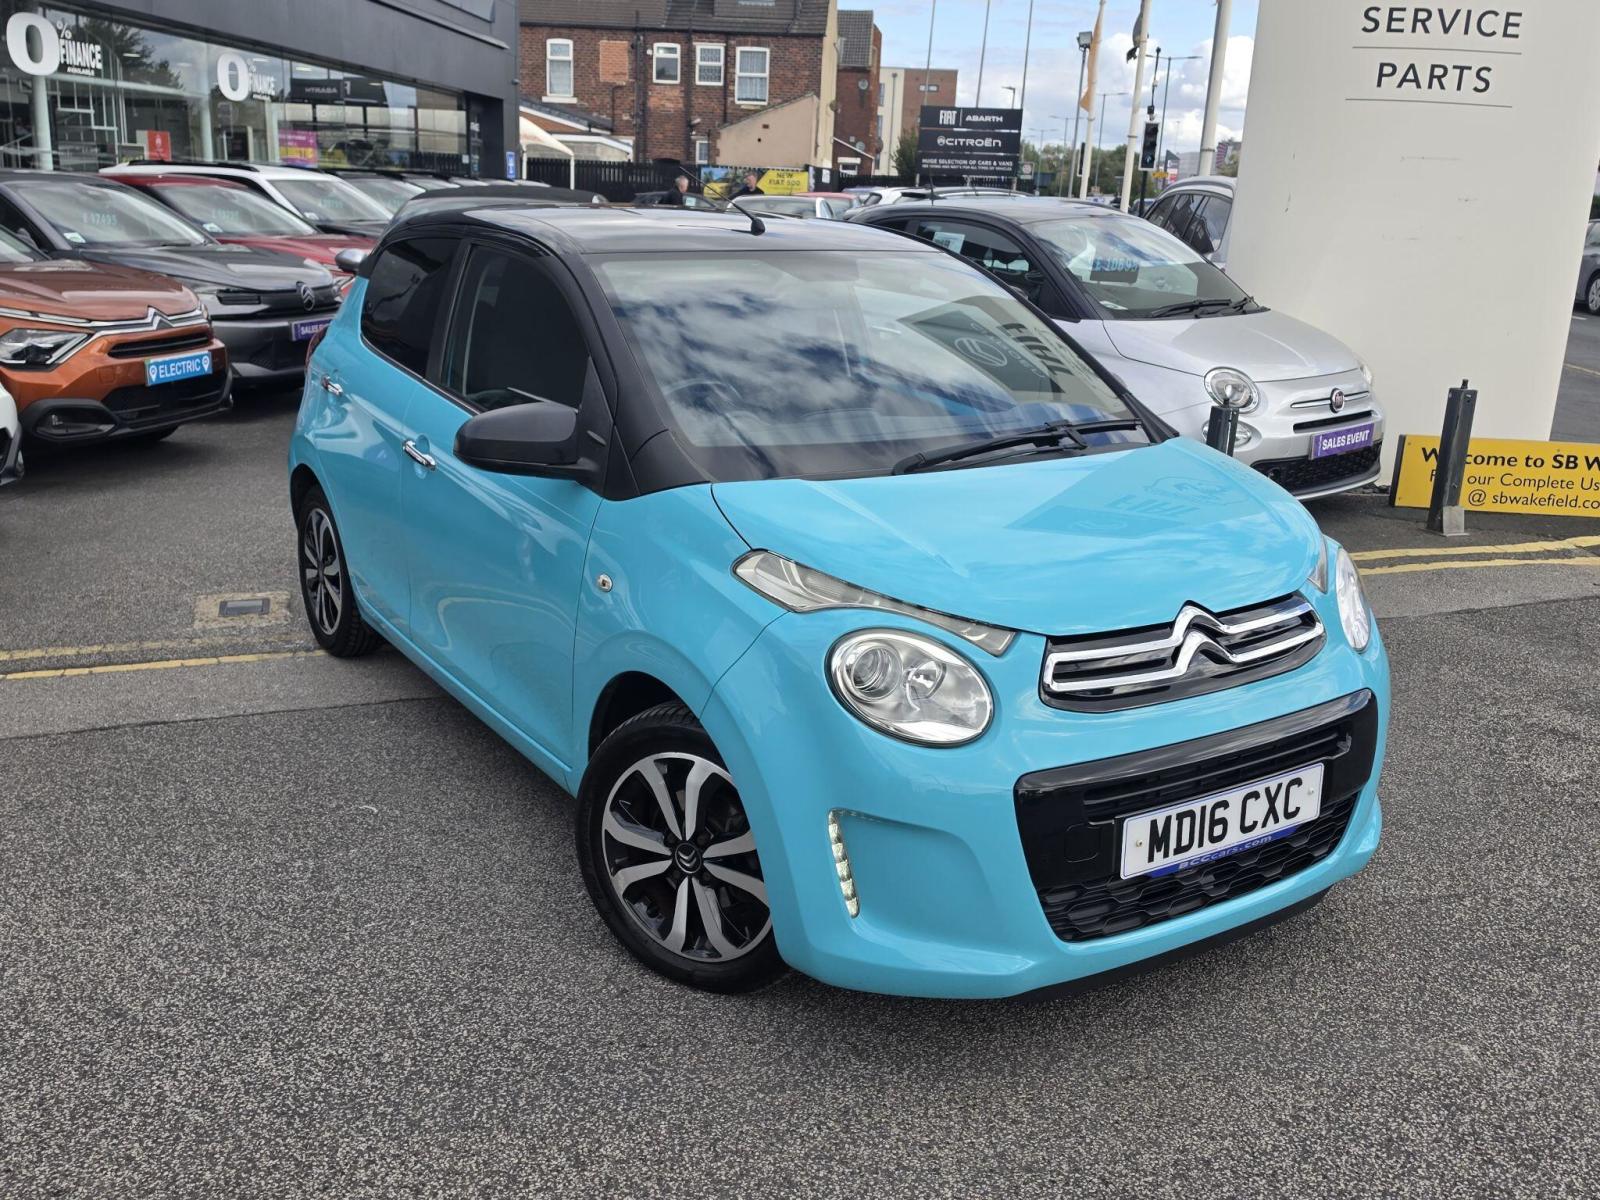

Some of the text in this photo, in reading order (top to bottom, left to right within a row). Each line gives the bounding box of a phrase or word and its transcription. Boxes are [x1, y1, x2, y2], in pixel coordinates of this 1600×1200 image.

[1361, 6, 1523, 39] SERVICE
[60, 38, 102, 69] FINANCE
[1376, 62, 1492, 93] PARTS
[939, 110, 1003, 125] FIAT ABARTH
[946, 138, 1001, 147] CITROËN
[159, 358, 201, 379] ELECTRIC
[1322, 429, 1370, 451] SALES EVENT
[1421, 447, 1518, 468] Wcome
[1525, 454, 1545, 469] to
[1551, 453, 1579, 470] SB
[1467, 475, 1495, 486] our
[1500, 473, 1574, 491] Complete
[1468, 489, 1487, 506] @
[1147, 777, 1303, 864] MD16 CXC
